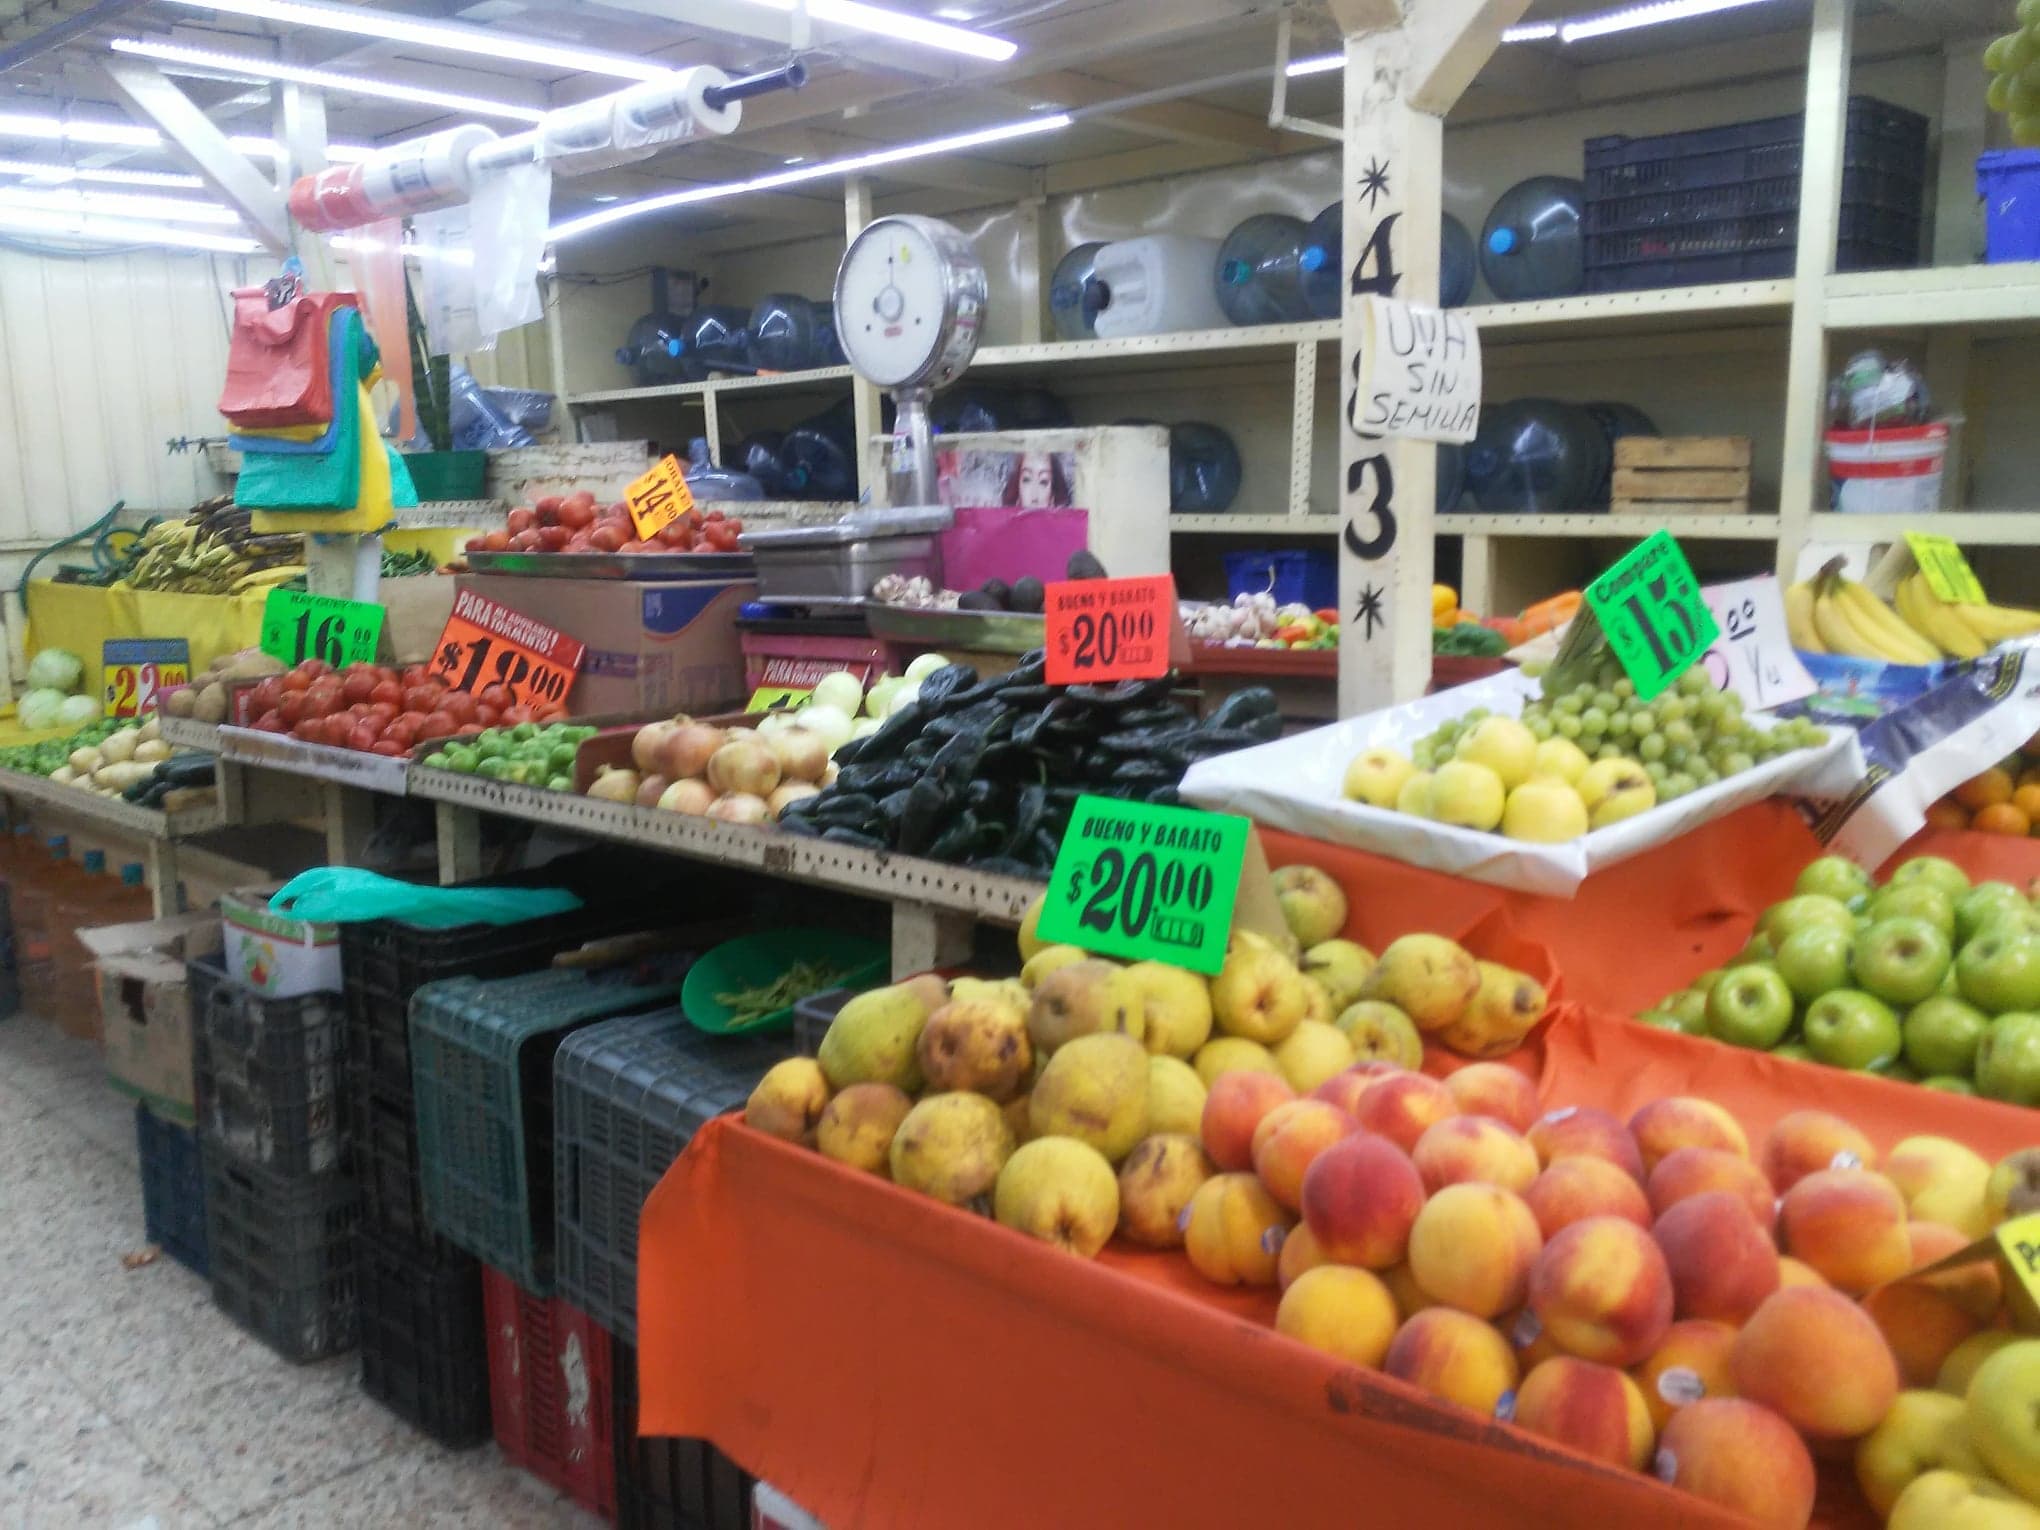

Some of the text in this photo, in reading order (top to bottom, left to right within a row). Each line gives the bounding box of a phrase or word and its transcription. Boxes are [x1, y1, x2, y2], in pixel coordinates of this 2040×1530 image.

[1407, 362, 1458, 395] SIN
[455, 590, 493, 627] PARA
[1110, 587, 1155, 606] BARATO
[762, 660, 795, 683] PARA
[1082, 817, 1223, 853] BUENO Y BARATO
